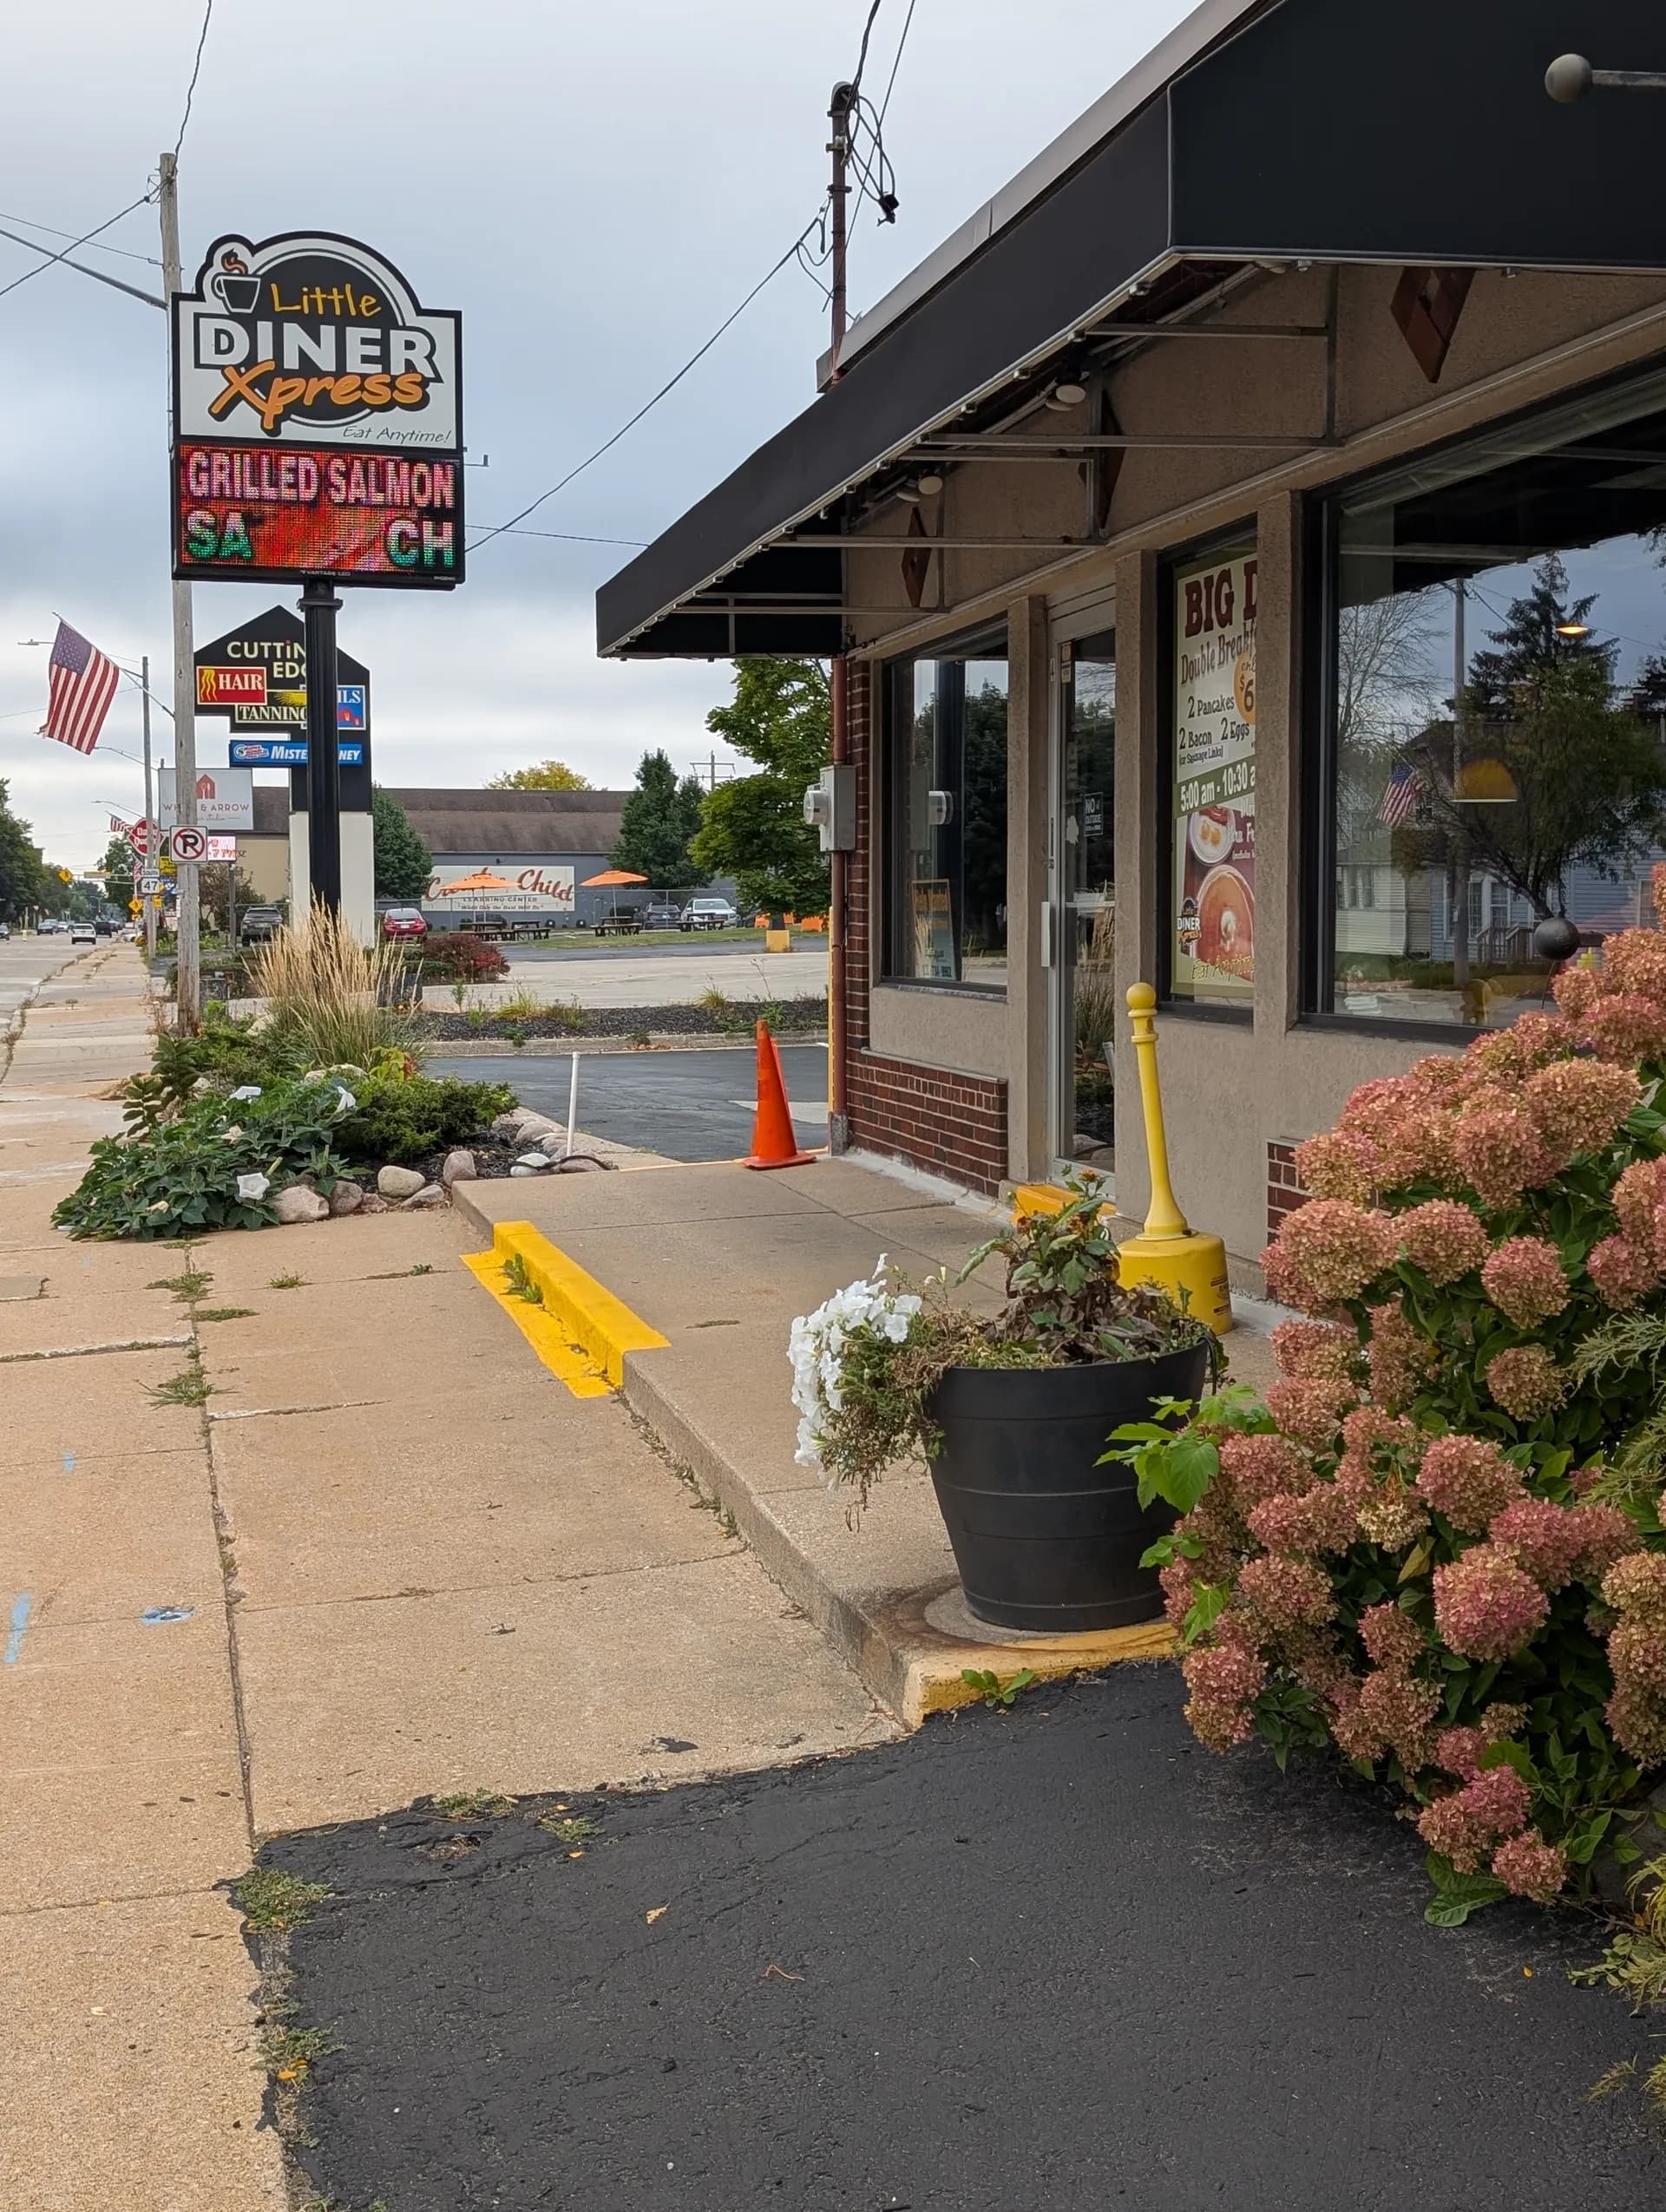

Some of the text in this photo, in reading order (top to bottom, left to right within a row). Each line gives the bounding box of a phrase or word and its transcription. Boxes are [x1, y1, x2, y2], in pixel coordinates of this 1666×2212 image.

[271, 283, 382, 317] Little
[199, 317, 436, 378] DINER
[207, 360, 424, 430] Xpress
[343, 426, 452, 444] Eat Anytime!
[188, 451, 456, 509] GRILLED SALMON
[1185, 567, 1234, 638] BIG
[272, 662, 305, 678] ED
[1181, 641, 1215, 685] Double
[219, 673, 264, 690] HAIR
[1188, 695, 1235, 718] 2 Pancakes
[1179, 717, 1250, 749] 2 Bacon 2 Eggs
[271, 746, 308, 760] MISTE
[338, 749, 361, 760] NEY
[1181, 781, 1199, 812] 5:00
[1201, 782, 1215, 805] am
[1222, 762, 1248, 796] 10:30
[211, 803, 250, 812] ARROW
[1085, 798, 1096, 814] NO
[143, 880, 158, 892] 47
[517, 868, 574, 901] Child
[1177, 918, 1201, 931] DINER
